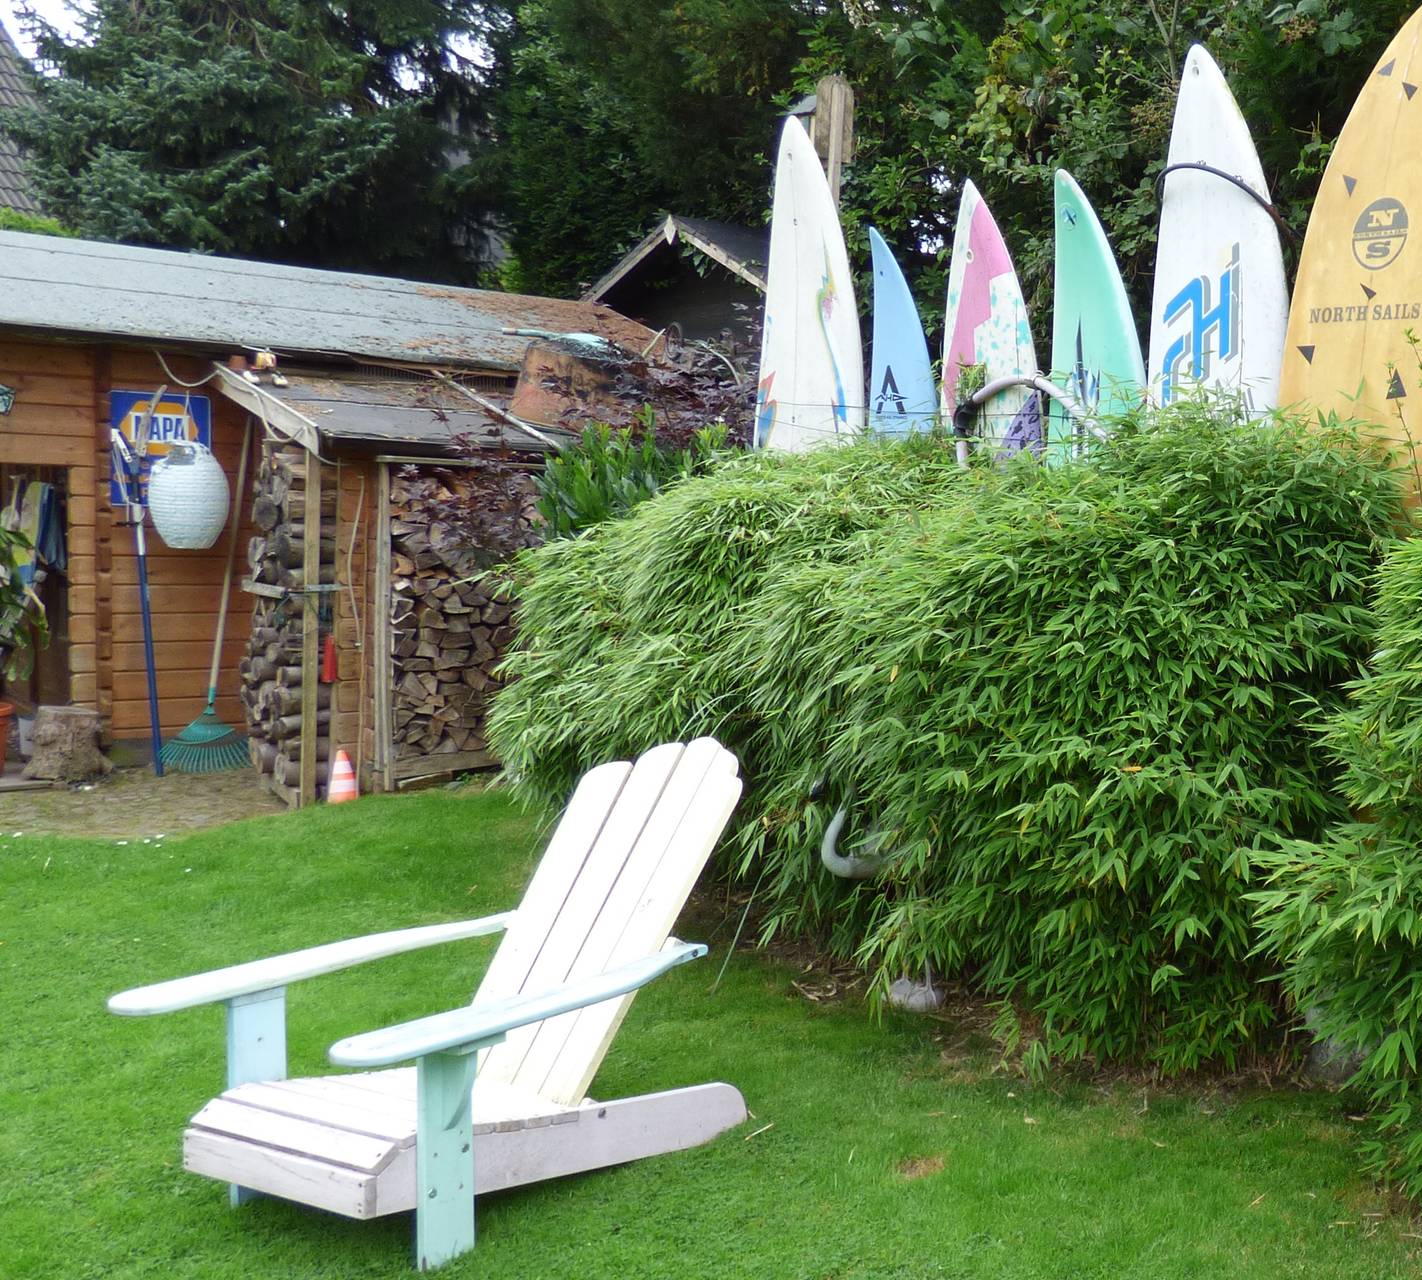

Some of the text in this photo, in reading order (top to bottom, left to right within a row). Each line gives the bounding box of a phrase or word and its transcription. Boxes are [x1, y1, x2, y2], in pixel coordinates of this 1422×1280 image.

[1367, 207, 1400, 228] N
[1365, 240, 1391, 259] S
[1308, 302, 1421, 324] NORTH SAILS
